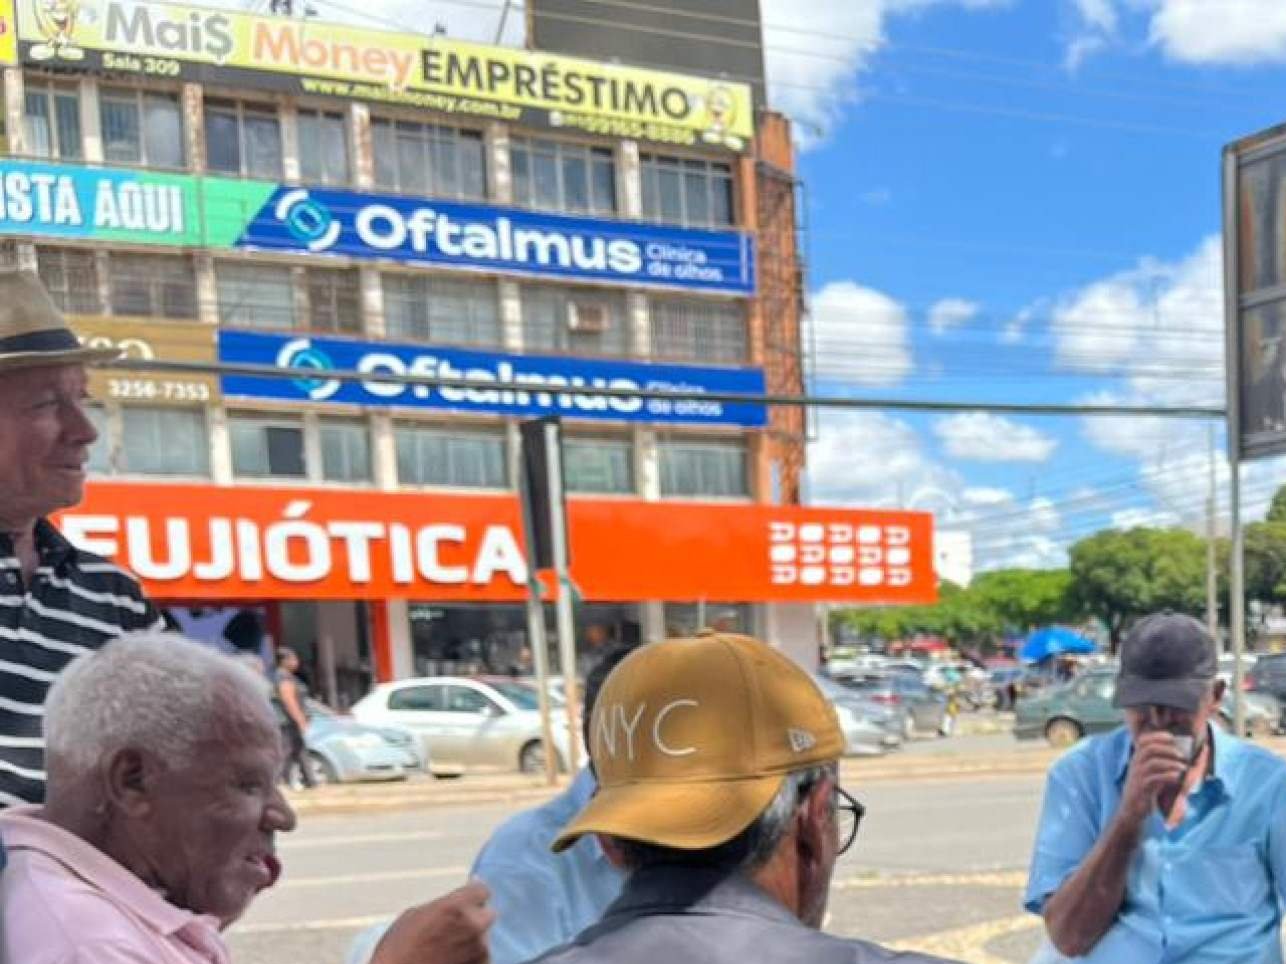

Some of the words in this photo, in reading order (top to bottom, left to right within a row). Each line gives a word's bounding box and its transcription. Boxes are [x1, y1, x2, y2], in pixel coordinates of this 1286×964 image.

[102, 52, 141, 71] Sala
[144, 58, 181, 76] 309
[253, 21, 414, 88] Money
[421, 50, 690, 119] EMPRÉSTIMO
[95, 179, 183, 233] AQUI
[356, 204, 642, 273] Oftalmus
[59, 500, 528, 585] FUJIÓTICA
[598, 699, 698, 760] NYC
